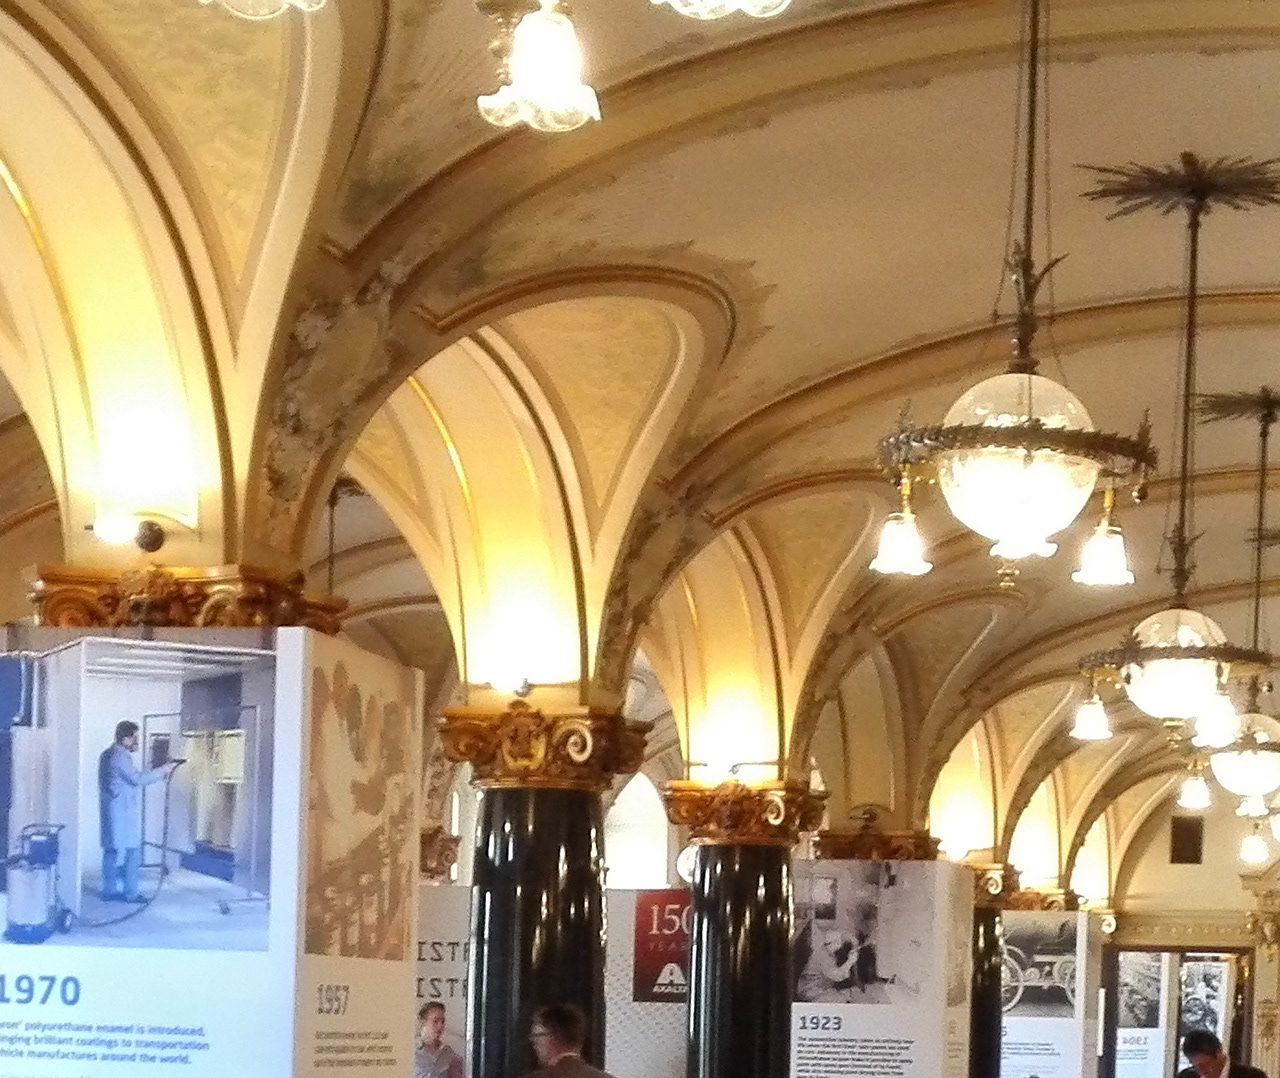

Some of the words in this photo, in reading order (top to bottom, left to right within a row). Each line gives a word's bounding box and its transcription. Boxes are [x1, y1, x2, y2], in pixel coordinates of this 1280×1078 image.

[24, 1020, 93, 1033] polyurethane
[136, 1025, 145, 1034] is
[799, 1016, 843, 1031] 1923
[33, 1034, 73, 1046] brilliant
[75, 1038, 119, 1049] coatings
[121, 1038, 132, 1048] to
[135, 1039, 210, 1051] transportation
[100, 1052, 137, 1063] around
[139, 1053, 157, 1063] the
